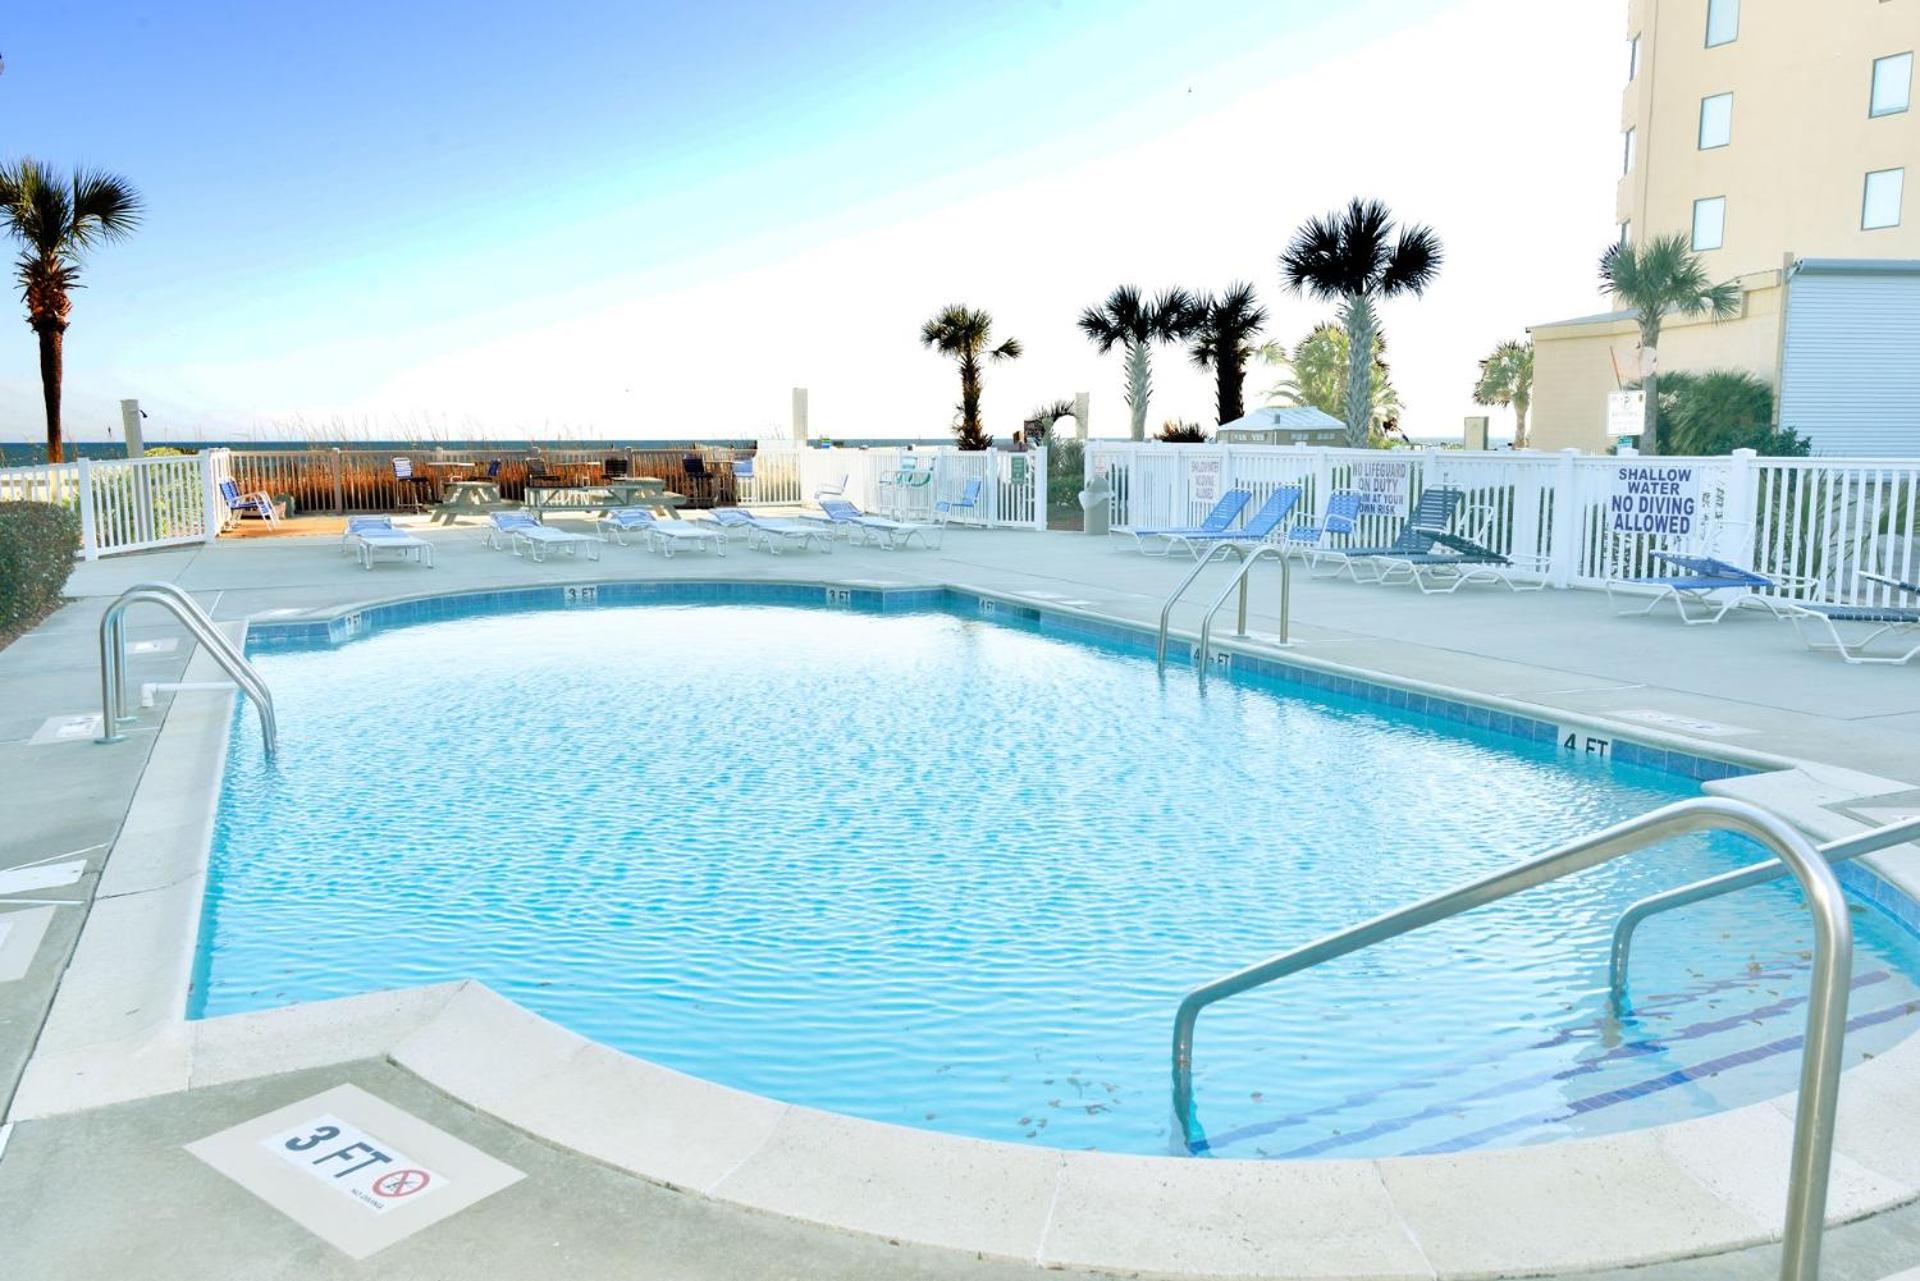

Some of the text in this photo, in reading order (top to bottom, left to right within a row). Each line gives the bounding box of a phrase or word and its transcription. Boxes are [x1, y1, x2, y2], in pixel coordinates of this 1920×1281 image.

[1353, 462, 1406, 478] NO LIFEGUARD
[1618, 467, 1692, 482] SHALLOW
[1359, 477, 1399, 494] ON DUTY
[1627, 481, 1680, 496] WATER
[1372, 493, 1382, 504] AT
[1383, 494, 1404, 505] YOUR
[1612, 494, 1695, 516] NO DIVING
[1377, 503, 1396, 515] RISK
[1613, 512, 1691, 535] ALLOWED
[568, 586, 595, 602] 3 FT
[1217, 652, 1230, 666] FT
[1563, 732, 1609, 758] 4 FT
[284, 1125, 393, 1179] 3 FT
